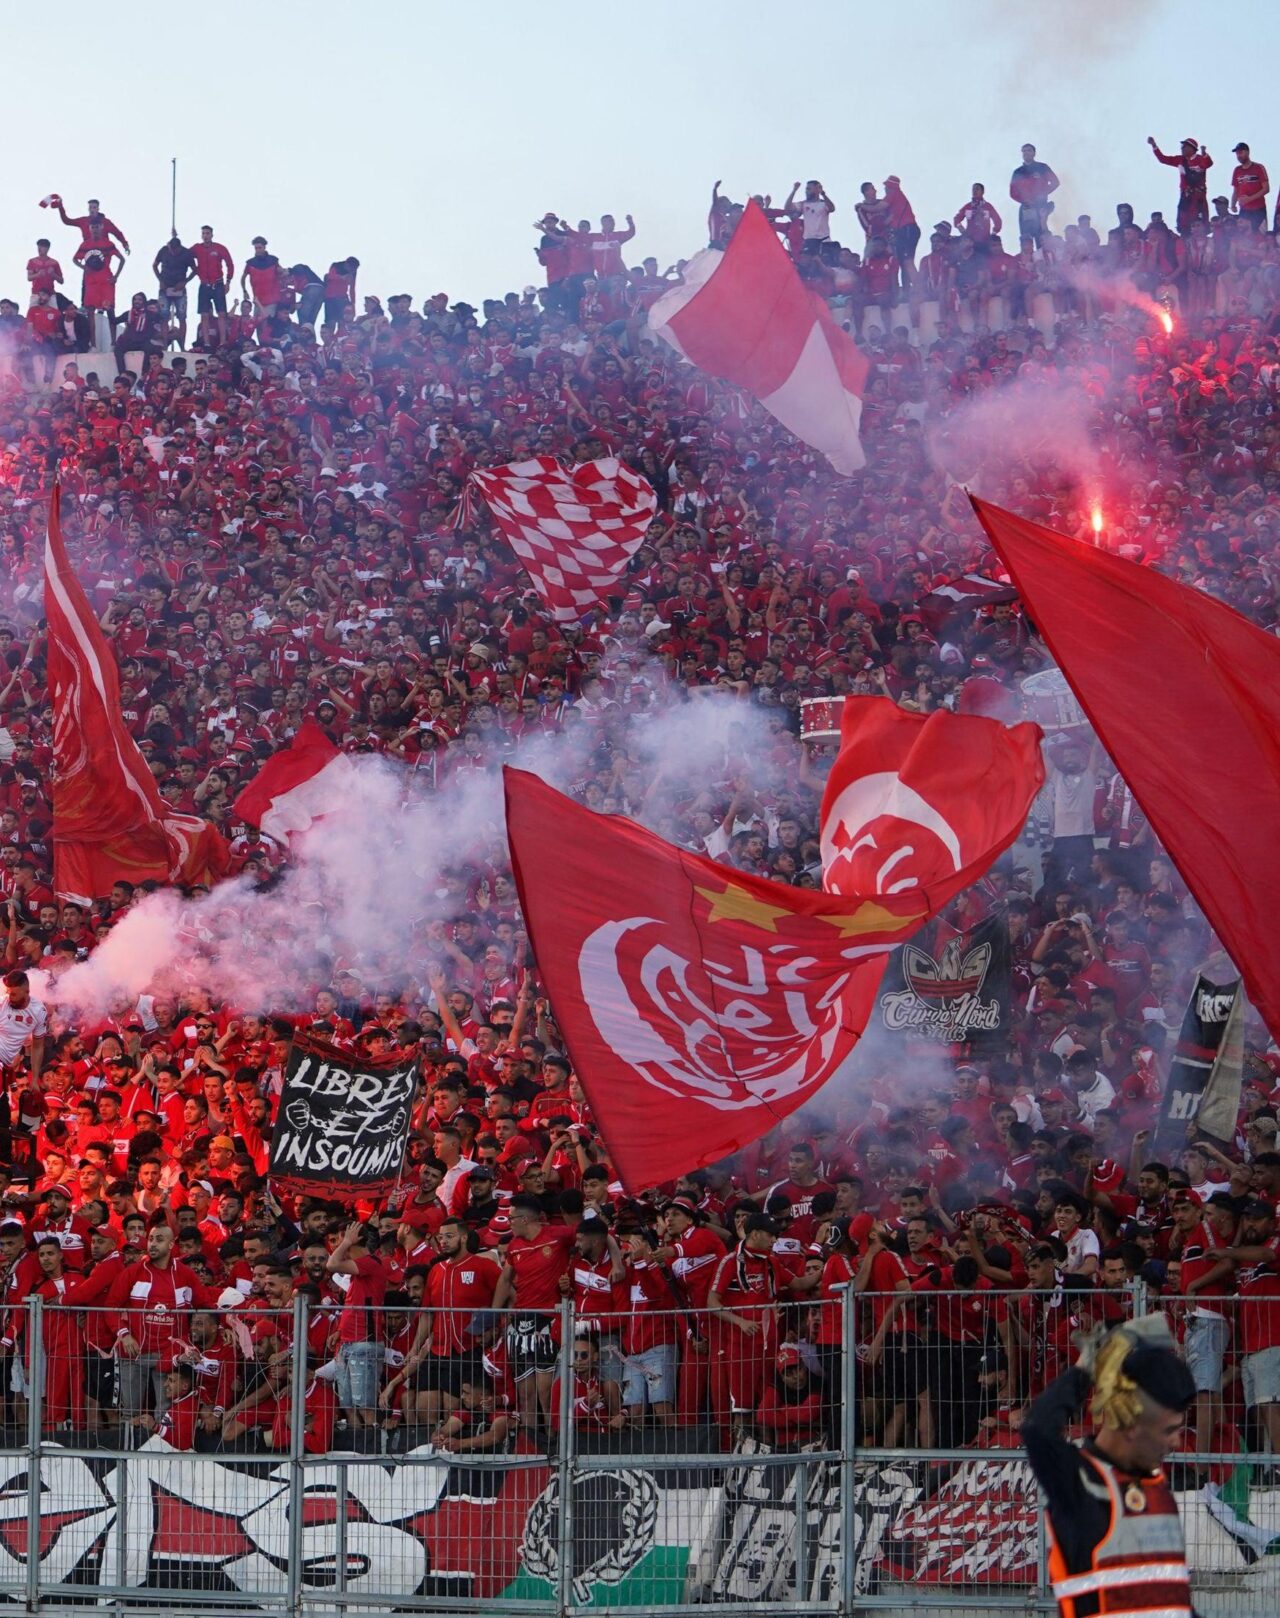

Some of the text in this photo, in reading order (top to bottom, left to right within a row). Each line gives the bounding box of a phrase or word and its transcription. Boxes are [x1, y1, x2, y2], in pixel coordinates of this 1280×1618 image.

[953, 993, 1000, 1030] Nord
[289, 1057, 416, 1111] LIBRES
[325, 1109, 394, 1144] ET
[273, 1132, 405, 1179] INSOUMIS
